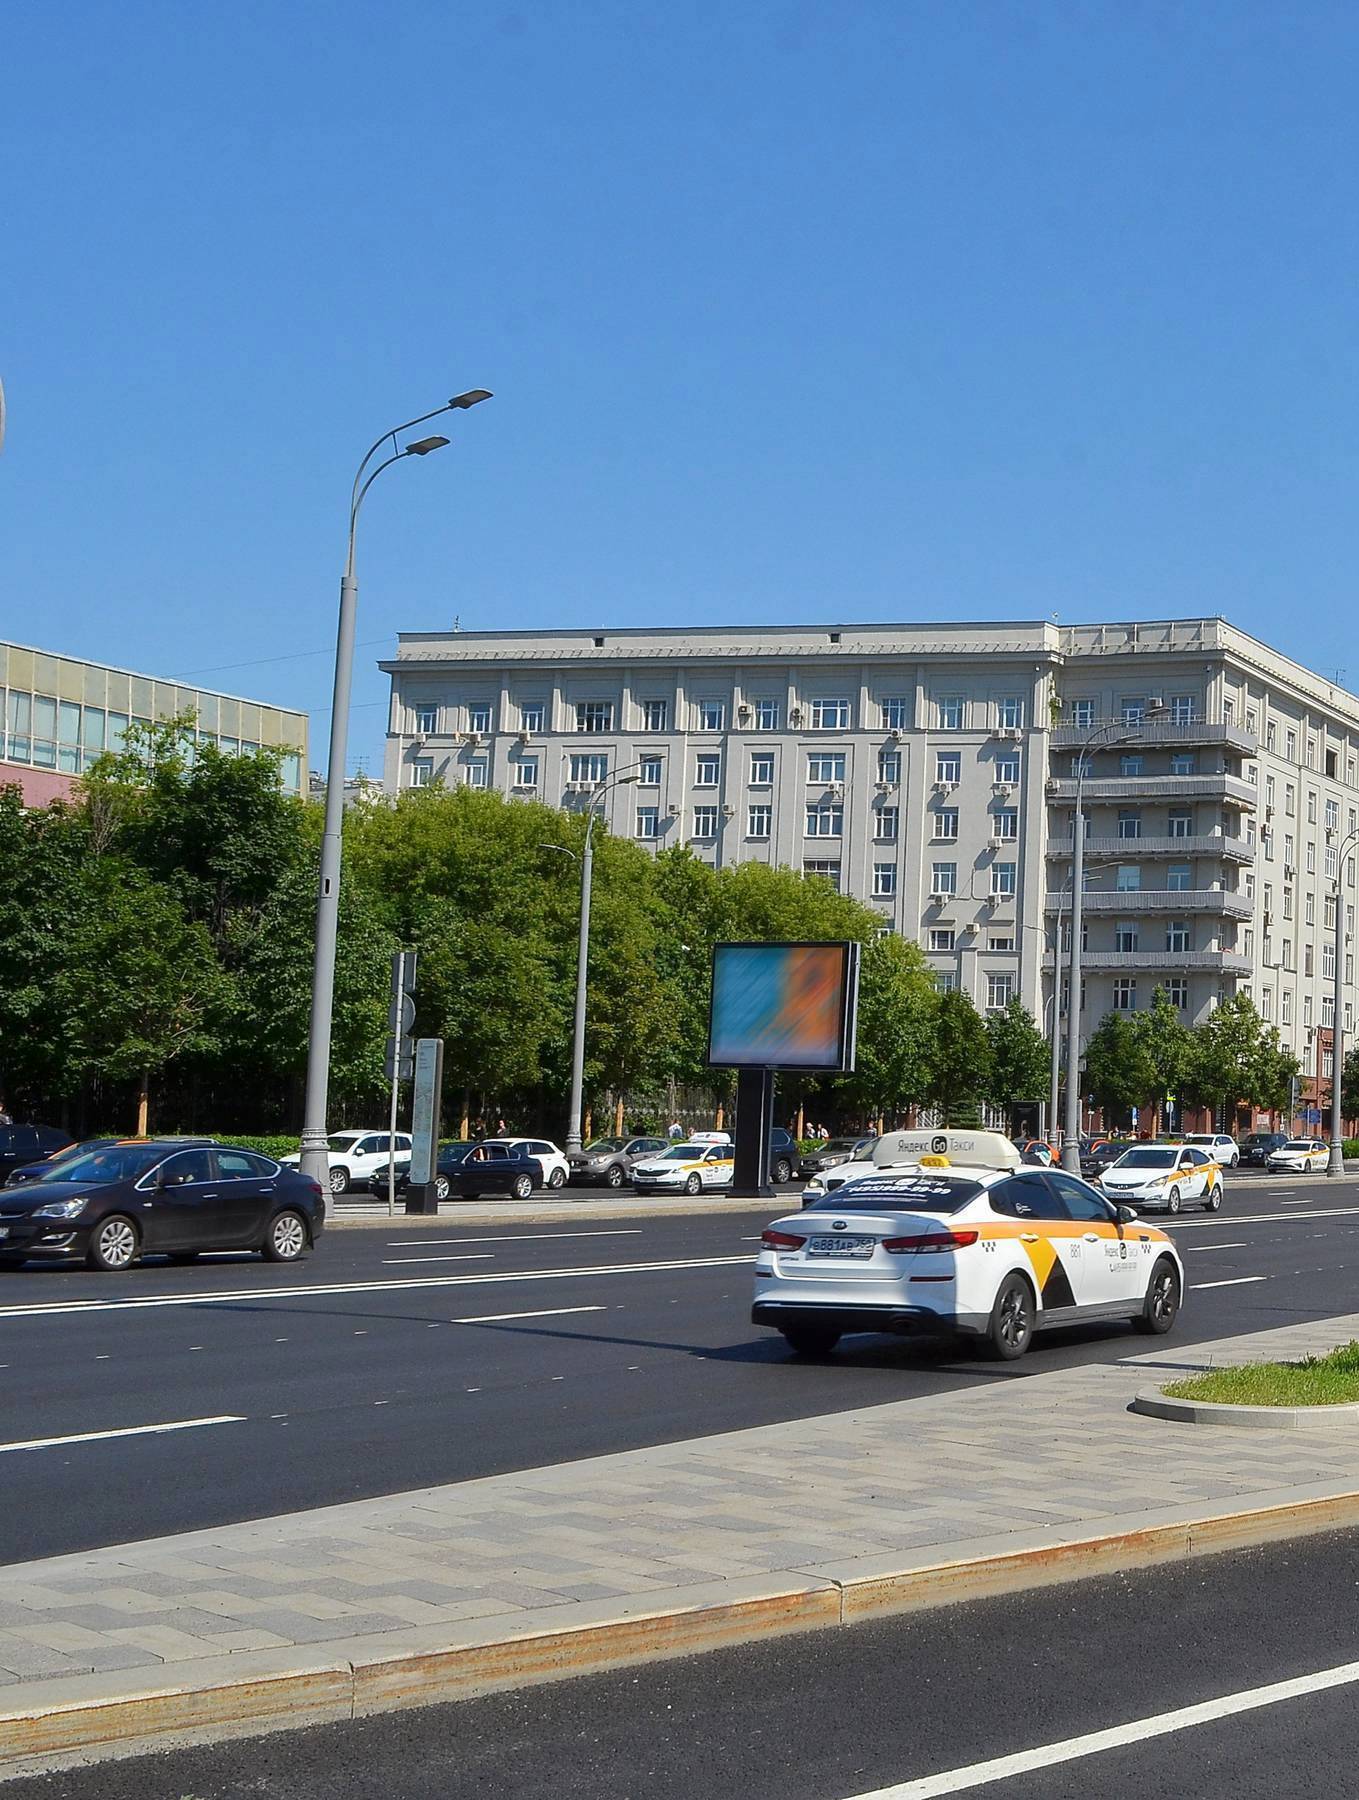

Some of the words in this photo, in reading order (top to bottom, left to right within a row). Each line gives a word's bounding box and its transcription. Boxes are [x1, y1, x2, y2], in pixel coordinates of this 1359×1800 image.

[897, 1139, 929, 1153] Яндекс
[932, 1137, 947, 1153] Go
[949, 1137, 975, 1152] Такси
